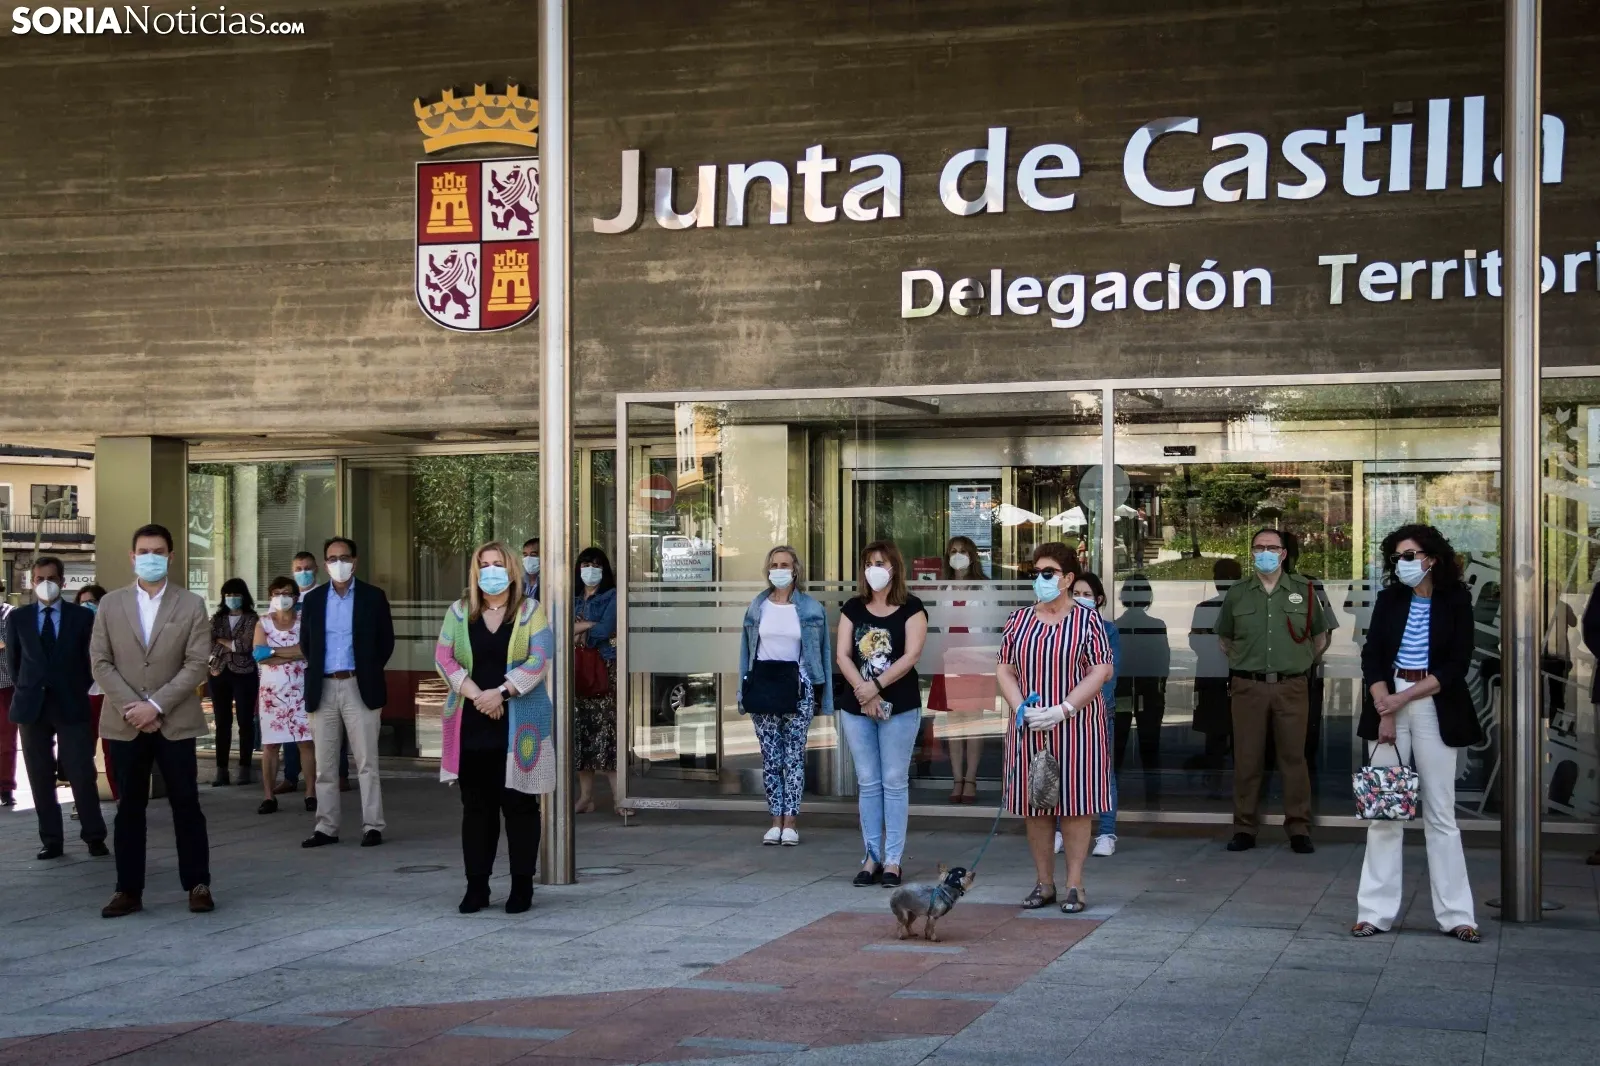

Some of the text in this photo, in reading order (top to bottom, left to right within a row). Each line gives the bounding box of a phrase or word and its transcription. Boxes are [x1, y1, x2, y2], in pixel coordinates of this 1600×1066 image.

[592, 143, 903, 235] Junta
[939, 126, 1081, 216] de
[901, 259, 1273, 329] Delegación
